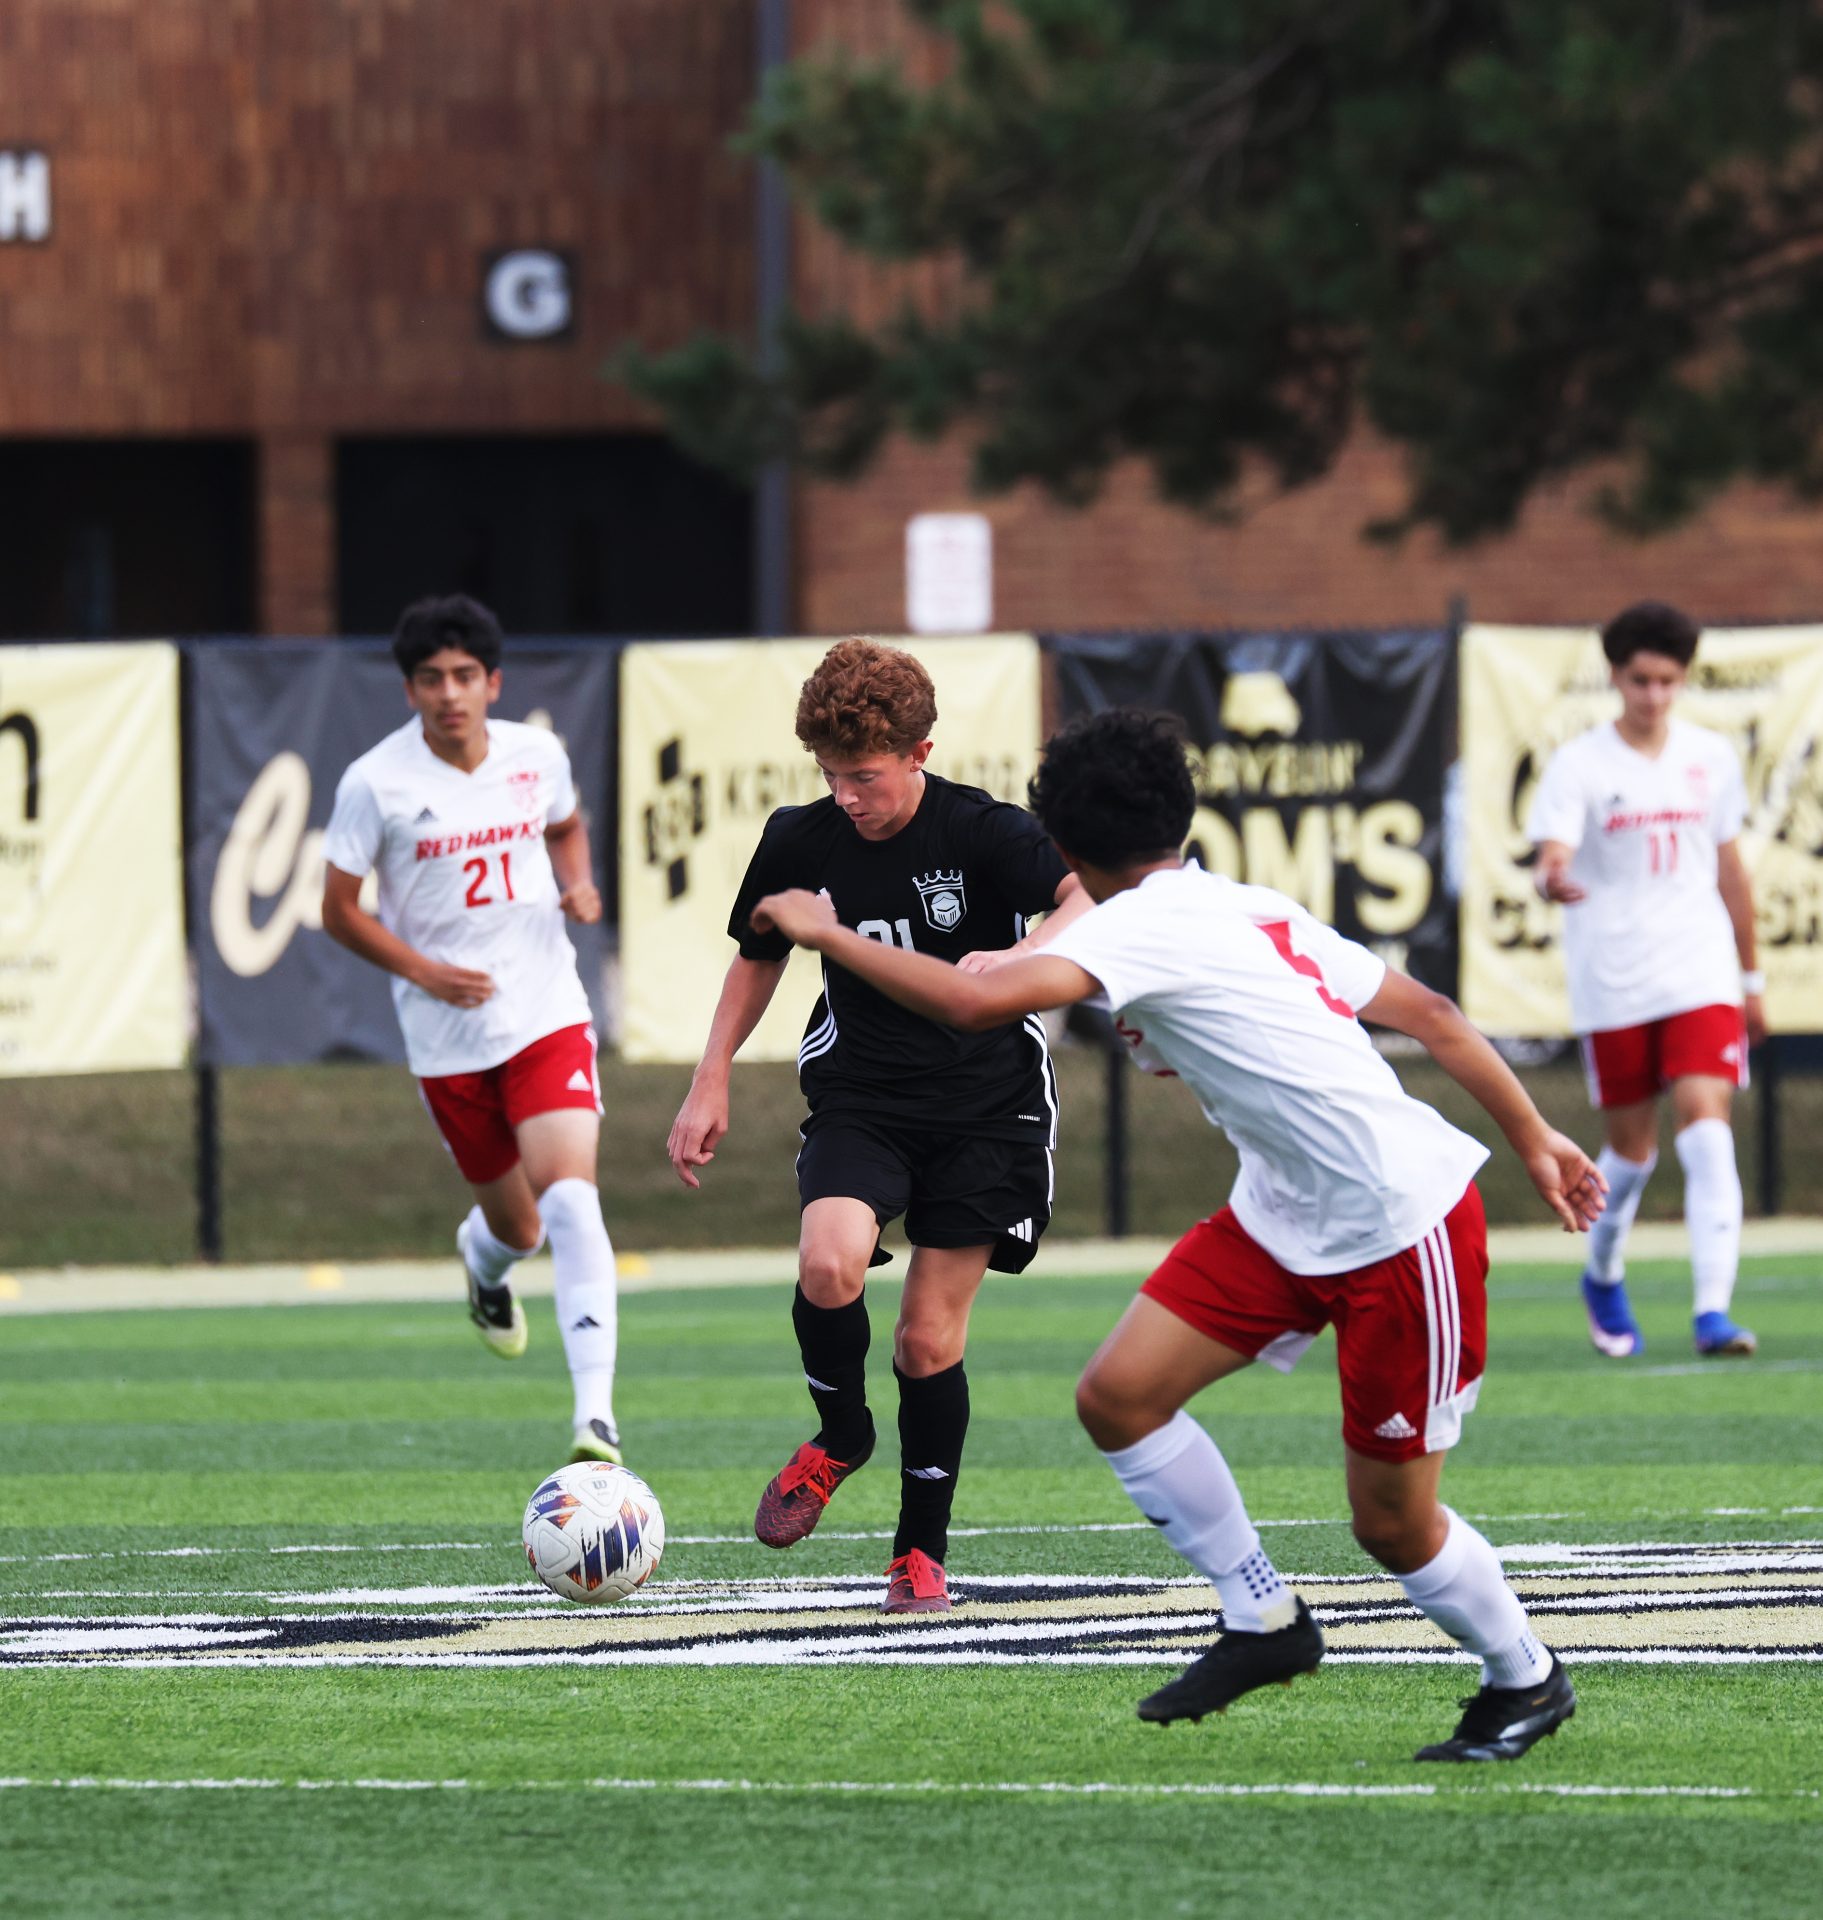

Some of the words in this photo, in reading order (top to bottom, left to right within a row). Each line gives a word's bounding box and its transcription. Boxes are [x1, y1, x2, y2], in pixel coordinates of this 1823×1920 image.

[0, 152, 49, 240] H
[487, 250, 570, 337] G
[463, 852, 514, 907] 21
[1180, 802, 1432, 934] M'S
[1648, 832, 1678, 875] 11
